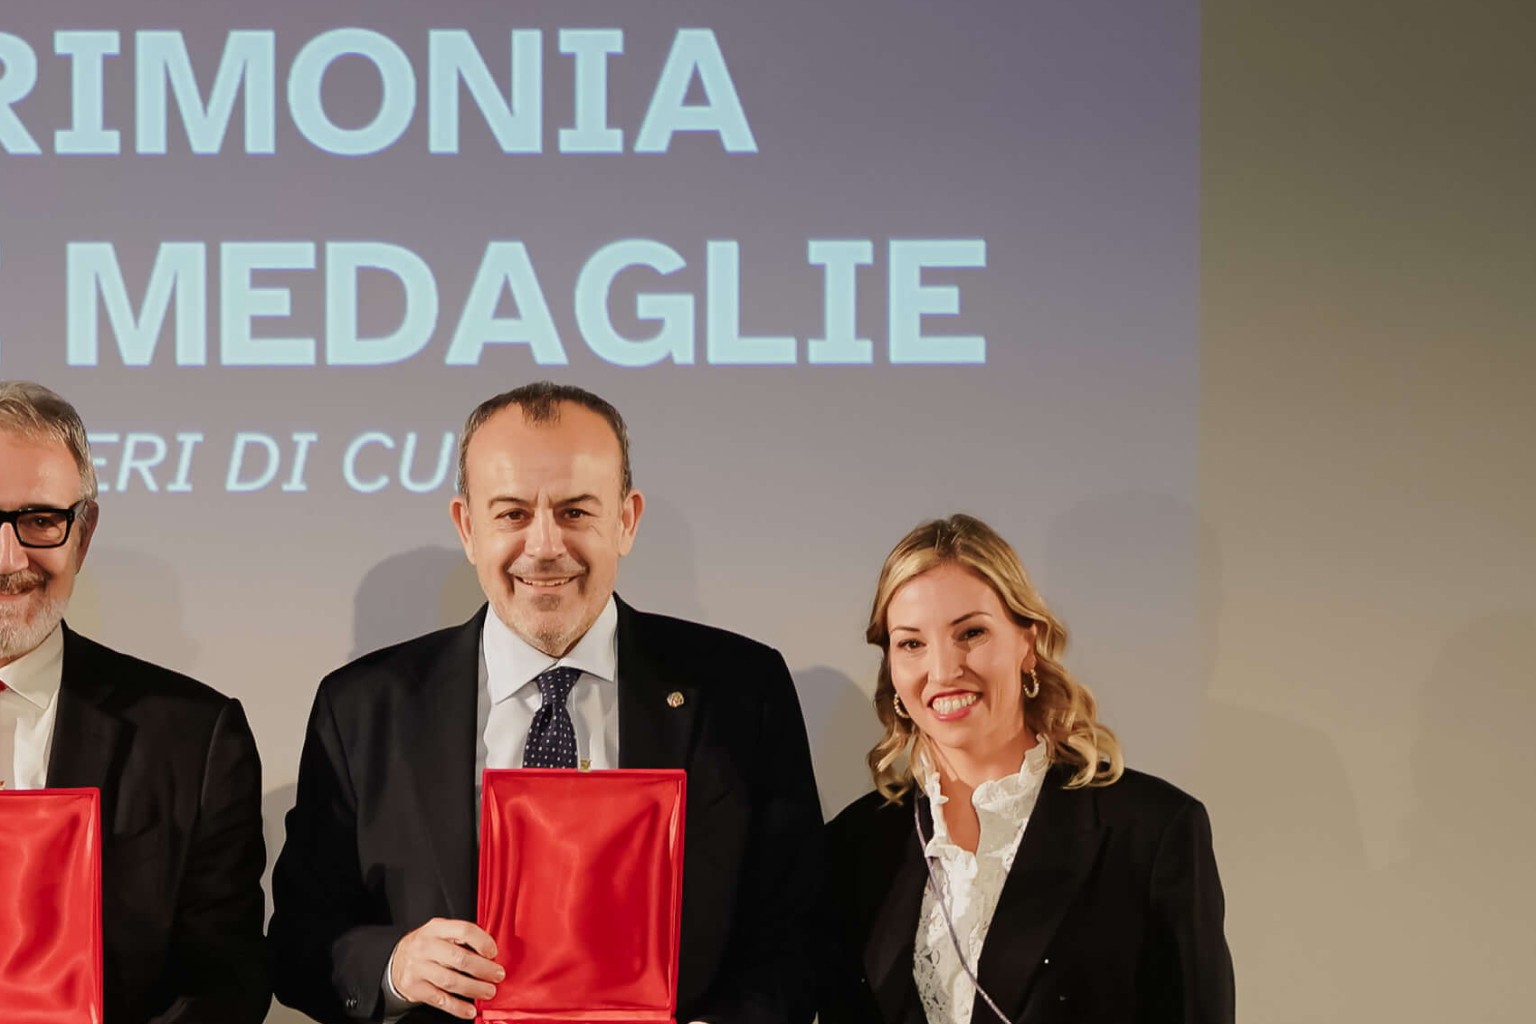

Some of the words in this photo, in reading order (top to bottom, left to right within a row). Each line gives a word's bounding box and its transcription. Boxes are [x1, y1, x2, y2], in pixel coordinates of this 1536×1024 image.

[65, 238, 986, 365] MEDAGLIE
[226, 431, 316, 491] DI
[342, 431, 460, 493] CU
